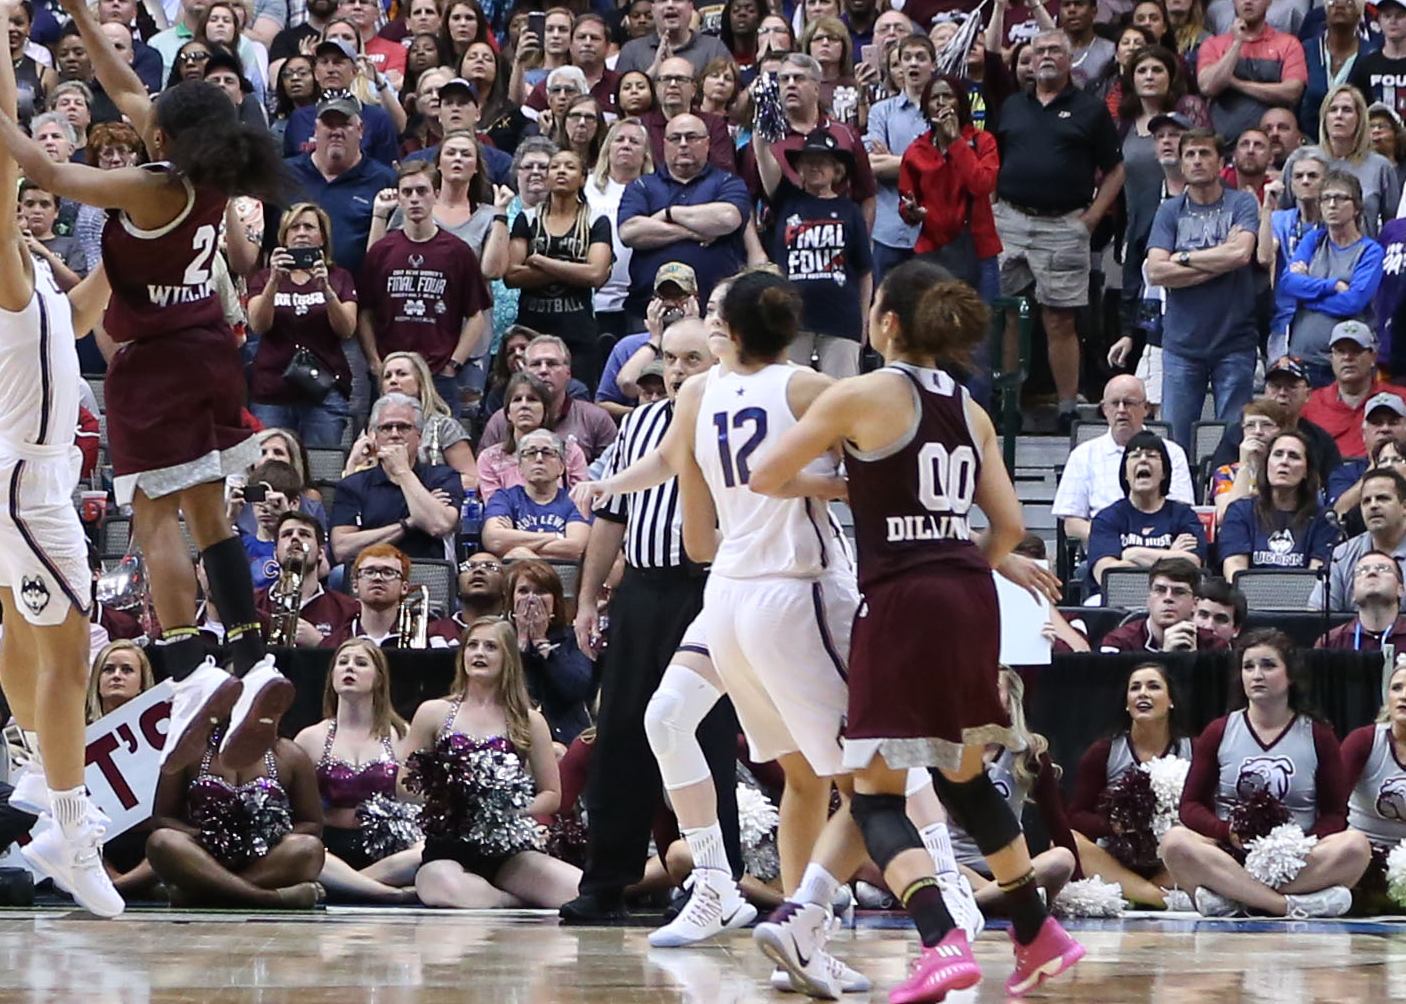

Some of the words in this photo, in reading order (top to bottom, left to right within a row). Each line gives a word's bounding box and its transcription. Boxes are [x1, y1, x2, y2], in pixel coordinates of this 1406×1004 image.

[785, 223, 845, 249] FINAL
[387, 276, 415, 292] FINAL
[417, 277, 447, 294] FOUR
[713, 407, 769, 488] 12
[917, 442, 976, 514] 00
[1252, 550, 1305, 566] UCONN
